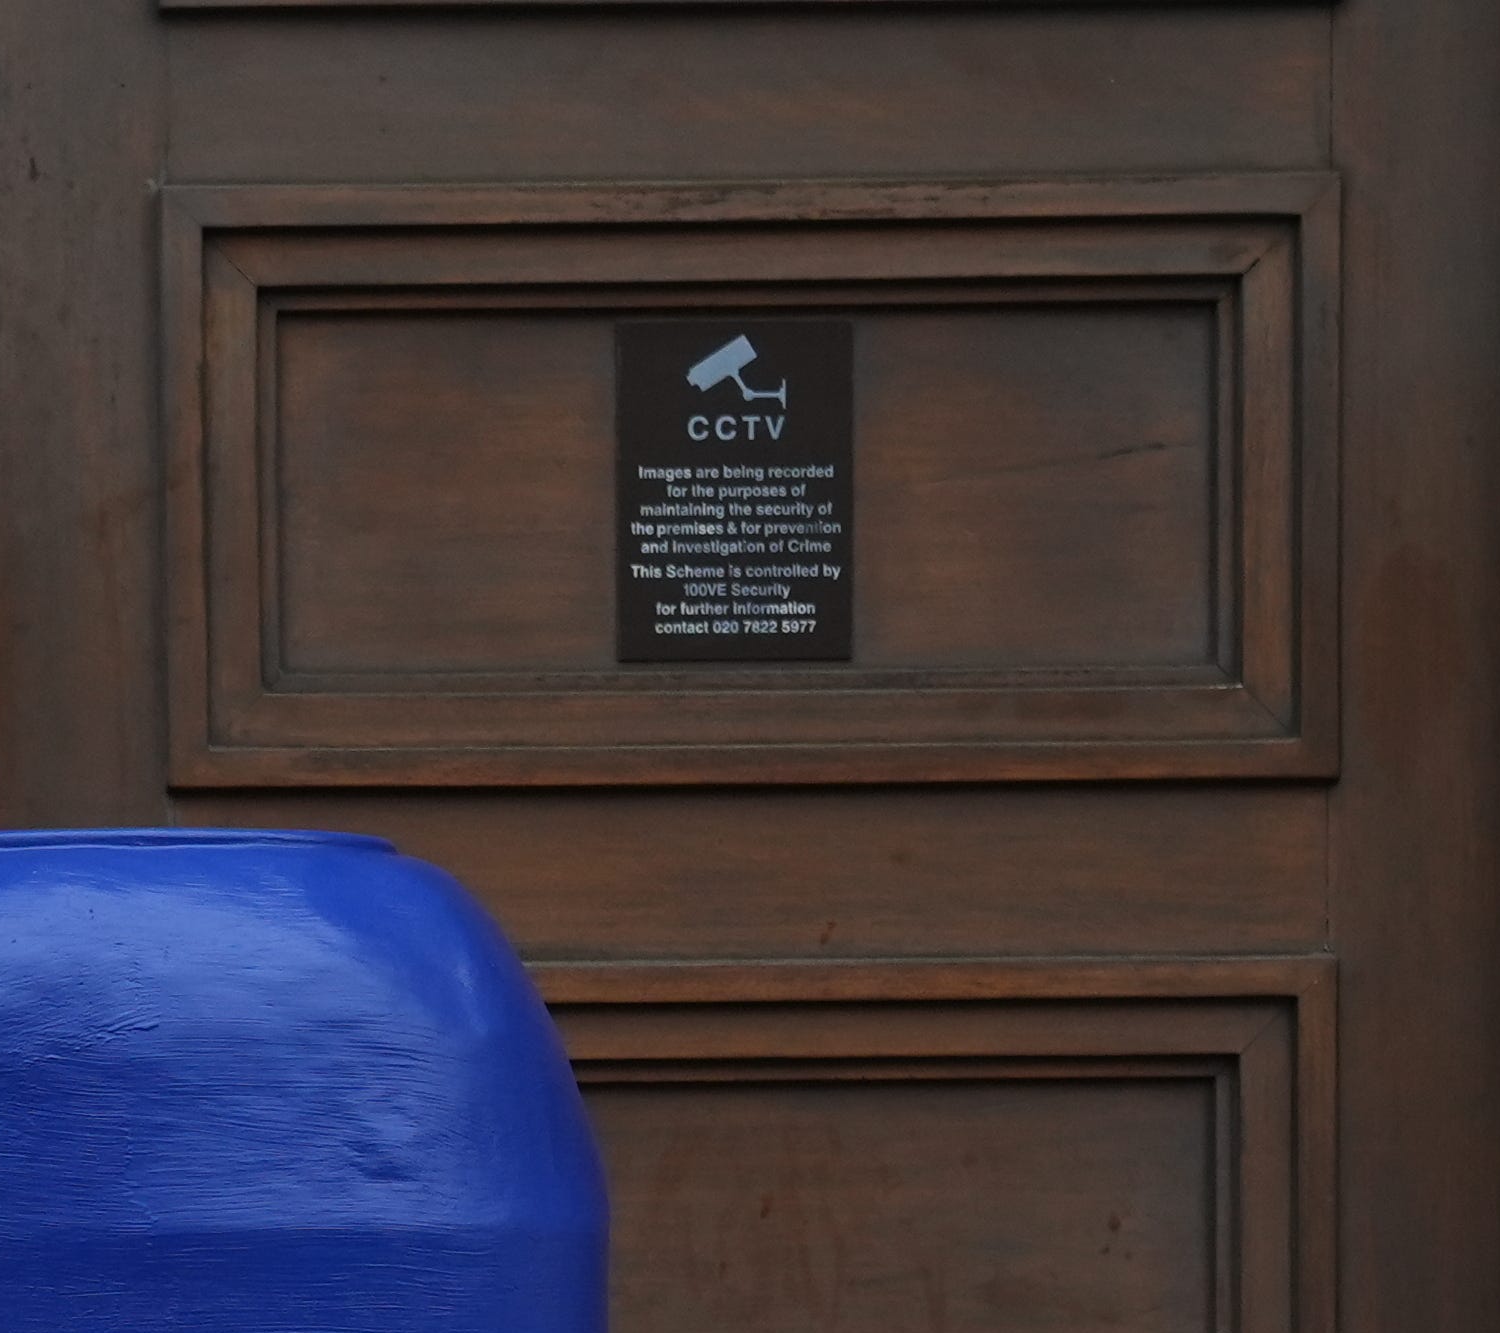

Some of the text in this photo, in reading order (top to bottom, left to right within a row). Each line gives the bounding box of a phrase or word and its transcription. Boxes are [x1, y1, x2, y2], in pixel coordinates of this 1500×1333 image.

[688, 416, 784, 440] CCTV
[639, 465, 834, 482] Images are being recorded
[667, 484, 806, 500] for the purposes of
[640, 502, 832, 519] maintaining the security of
[631, 520, 841, 538] the premises & for prevention
[641, 539, 831, 556] and investigation of Crime
[631, 564, 841, 580] This Scheme is controlled by
[731, 583, 790, 599] Security
[656, 601, 815, 615] for further information
[655, 621, 709, 634] contact
[713, 620, 739, 633] 020
[781, 619, 816, 633] 5977
